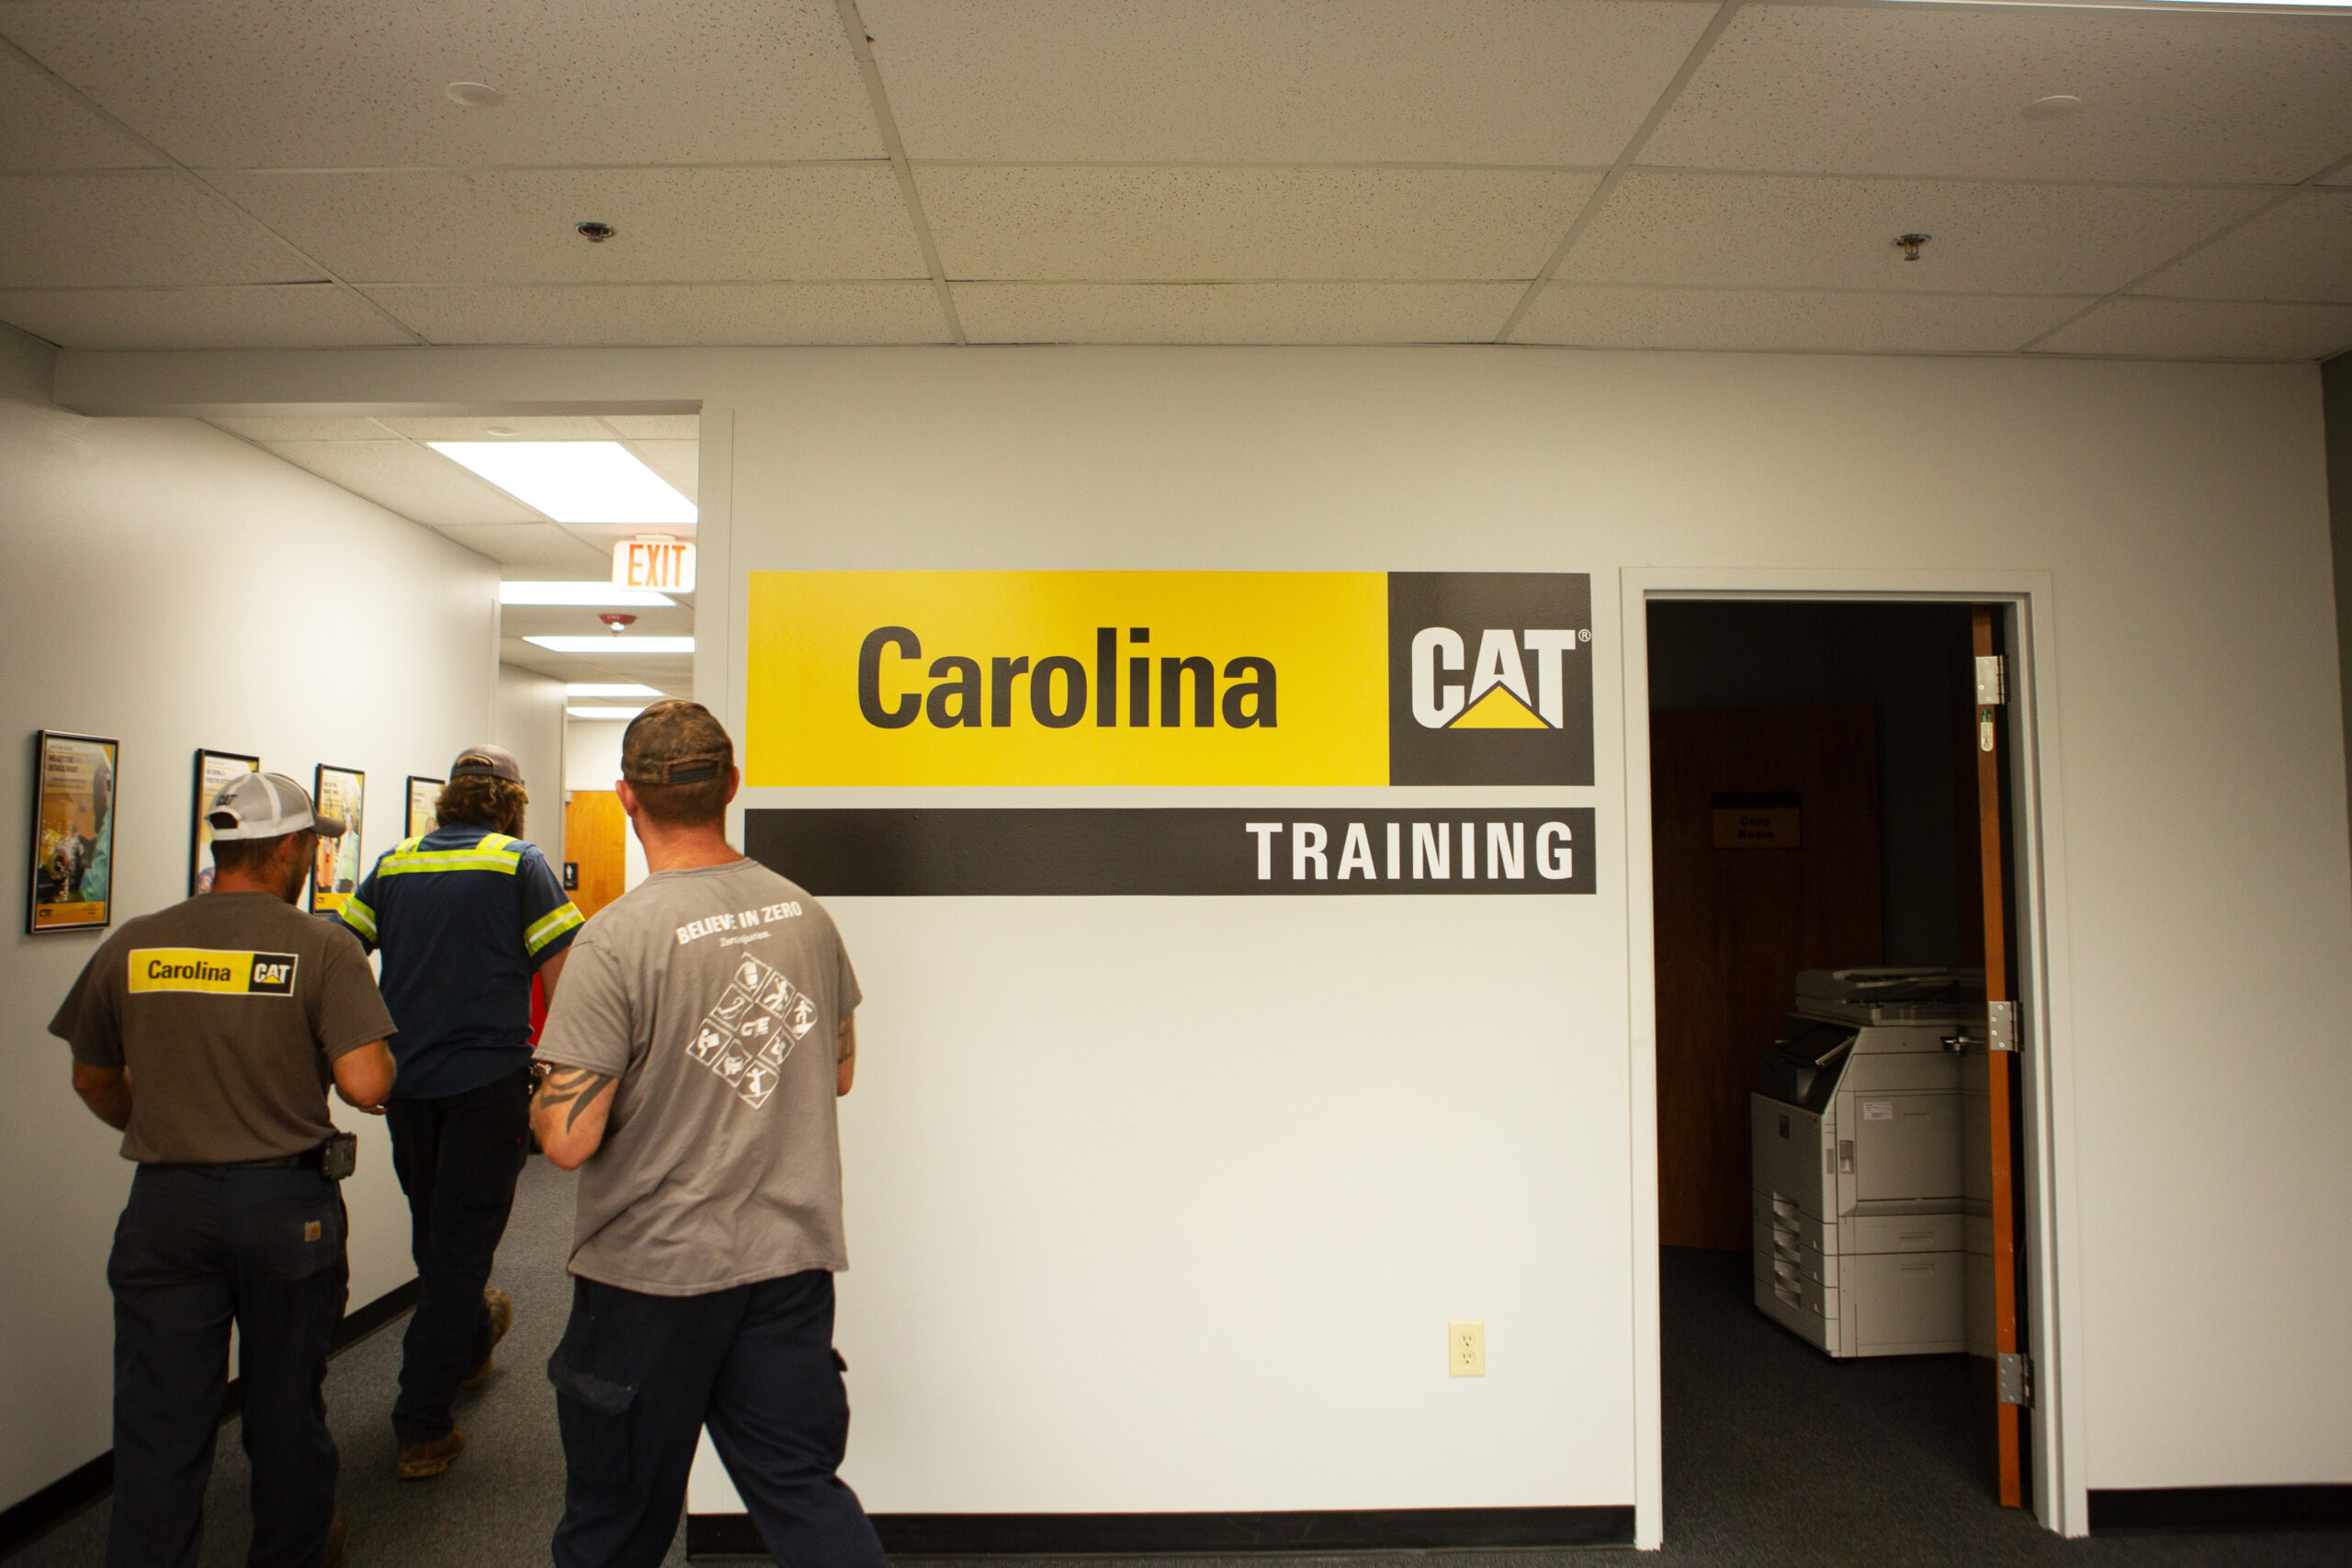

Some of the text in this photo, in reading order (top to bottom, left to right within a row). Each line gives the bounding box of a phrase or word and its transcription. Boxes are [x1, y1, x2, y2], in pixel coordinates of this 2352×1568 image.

[628, 544, 686, 587] EXIT
[858, 626, 1278, 729] Carolina
[1737, 829, 1774, 840] Room
[1739, 816, 1771, 828] Copy
[1246, 821, 1574, 881] TRAINING
[738, 909, 761, 929] IN
[761, 900, 803, 924] ZERO
[148, 959, 291, 985] Carolina CAT
